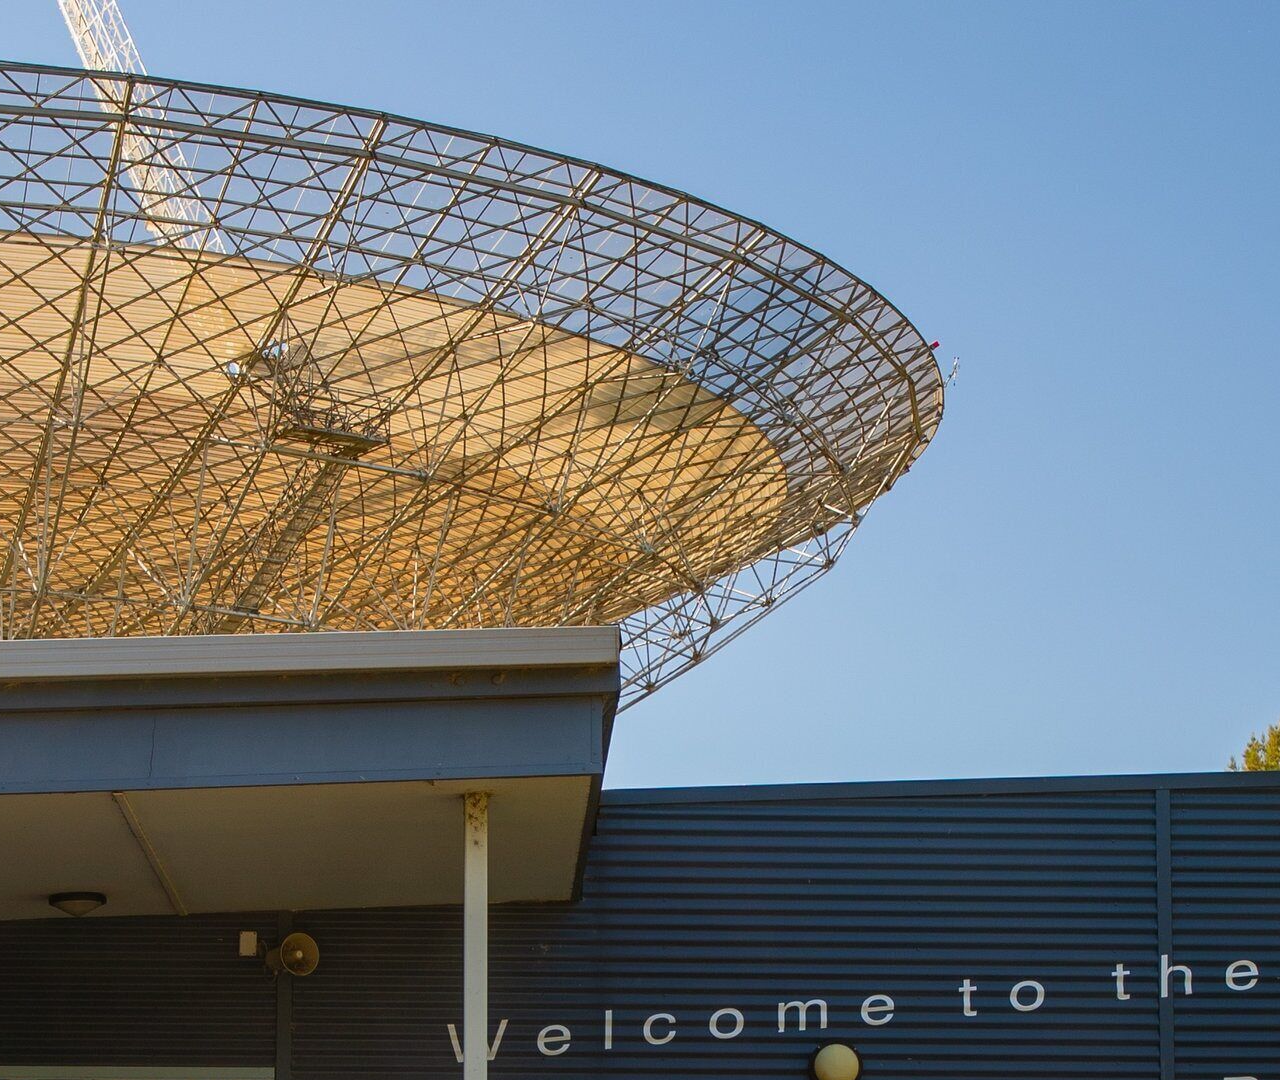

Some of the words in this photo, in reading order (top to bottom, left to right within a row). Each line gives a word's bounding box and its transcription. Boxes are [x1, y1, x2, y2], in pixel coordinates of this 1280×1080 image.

[446, 993, 896, 1063] Welcome
[958, 978, 1046, 1018] to
[1111, 953, 1260, 1001] the
